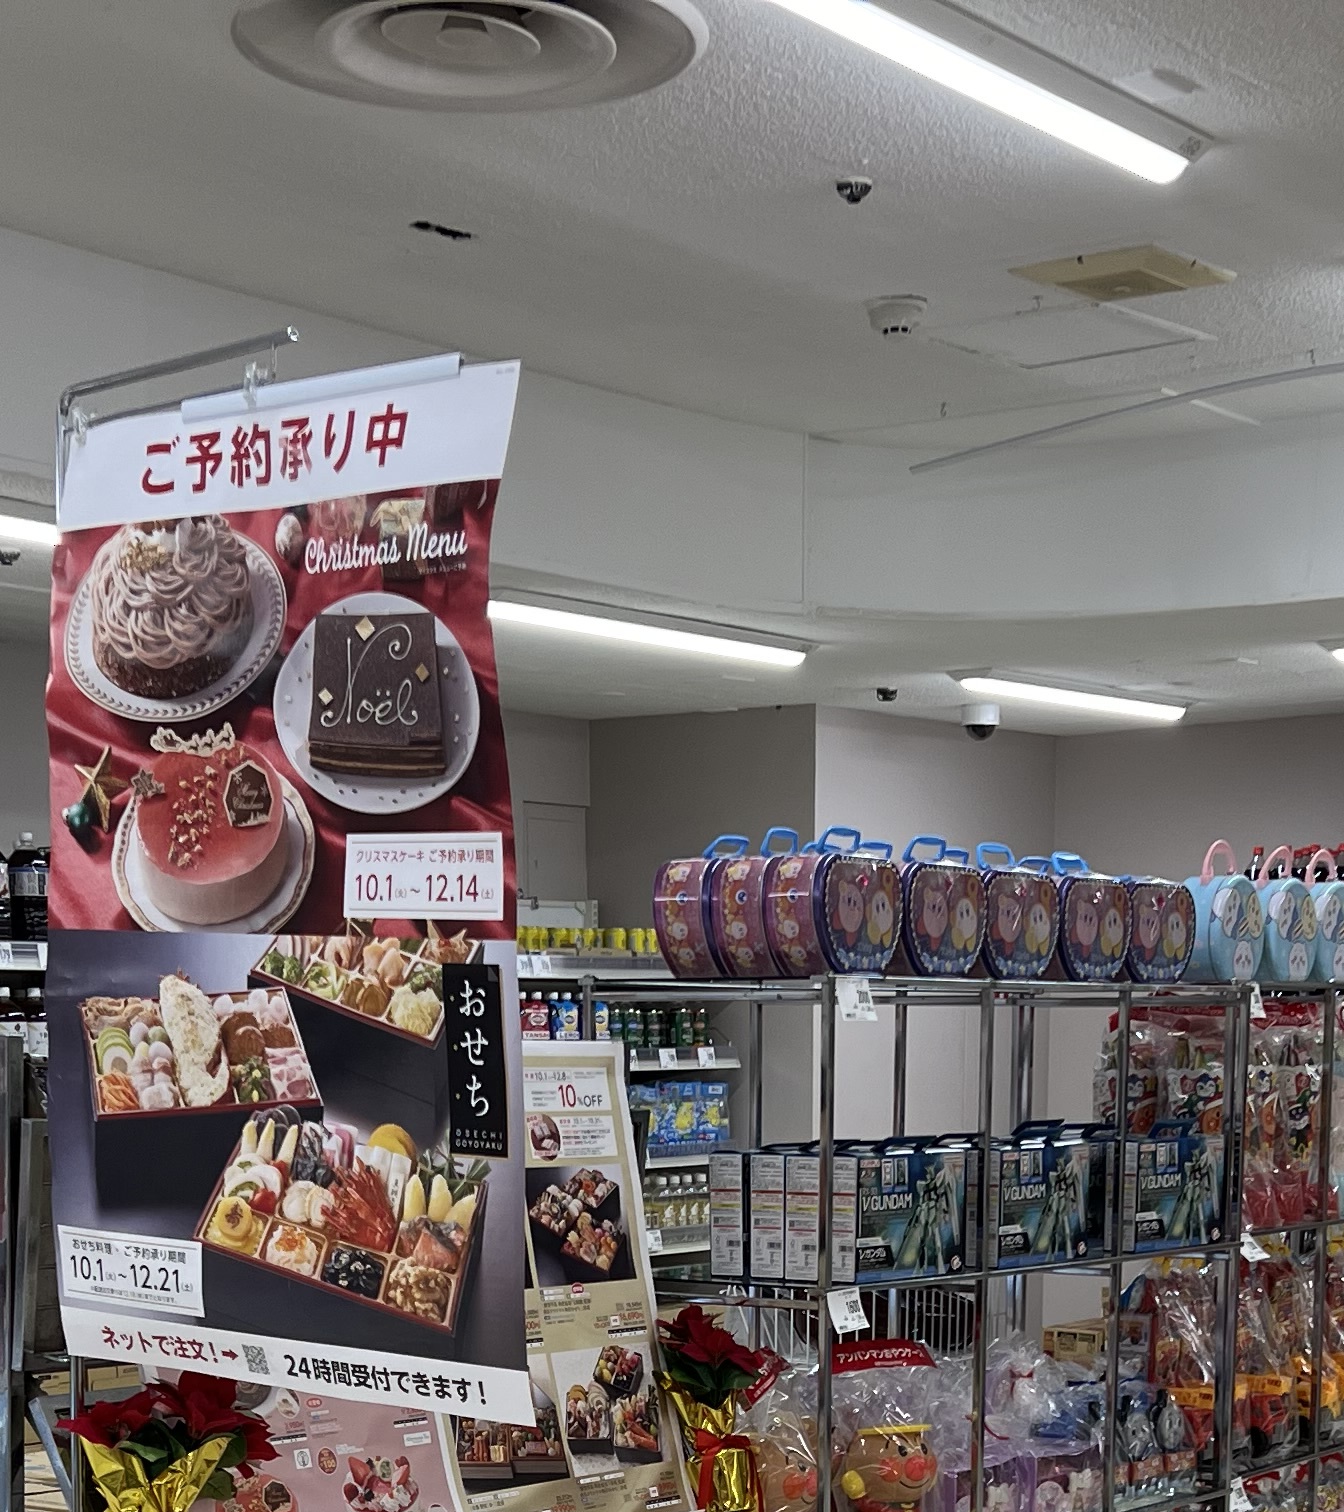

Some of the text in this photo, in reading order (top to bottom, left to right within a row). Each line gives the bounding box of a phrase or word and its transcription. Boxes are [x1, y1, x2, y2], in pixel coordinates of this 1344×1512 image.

[140, 402, 409, 495] ご予約承り中
[304, 527, 401, 576] Christmas
[404, 520, 469, 562] Menu
[320, 622, 420, 729] Noël
[355, 848, 495, 865] クリスマスケーキ ご予約承り期間
[459, 980, 489, 1117] おせち
[283, 1353, 488, 1406] 24時間受付できます!
